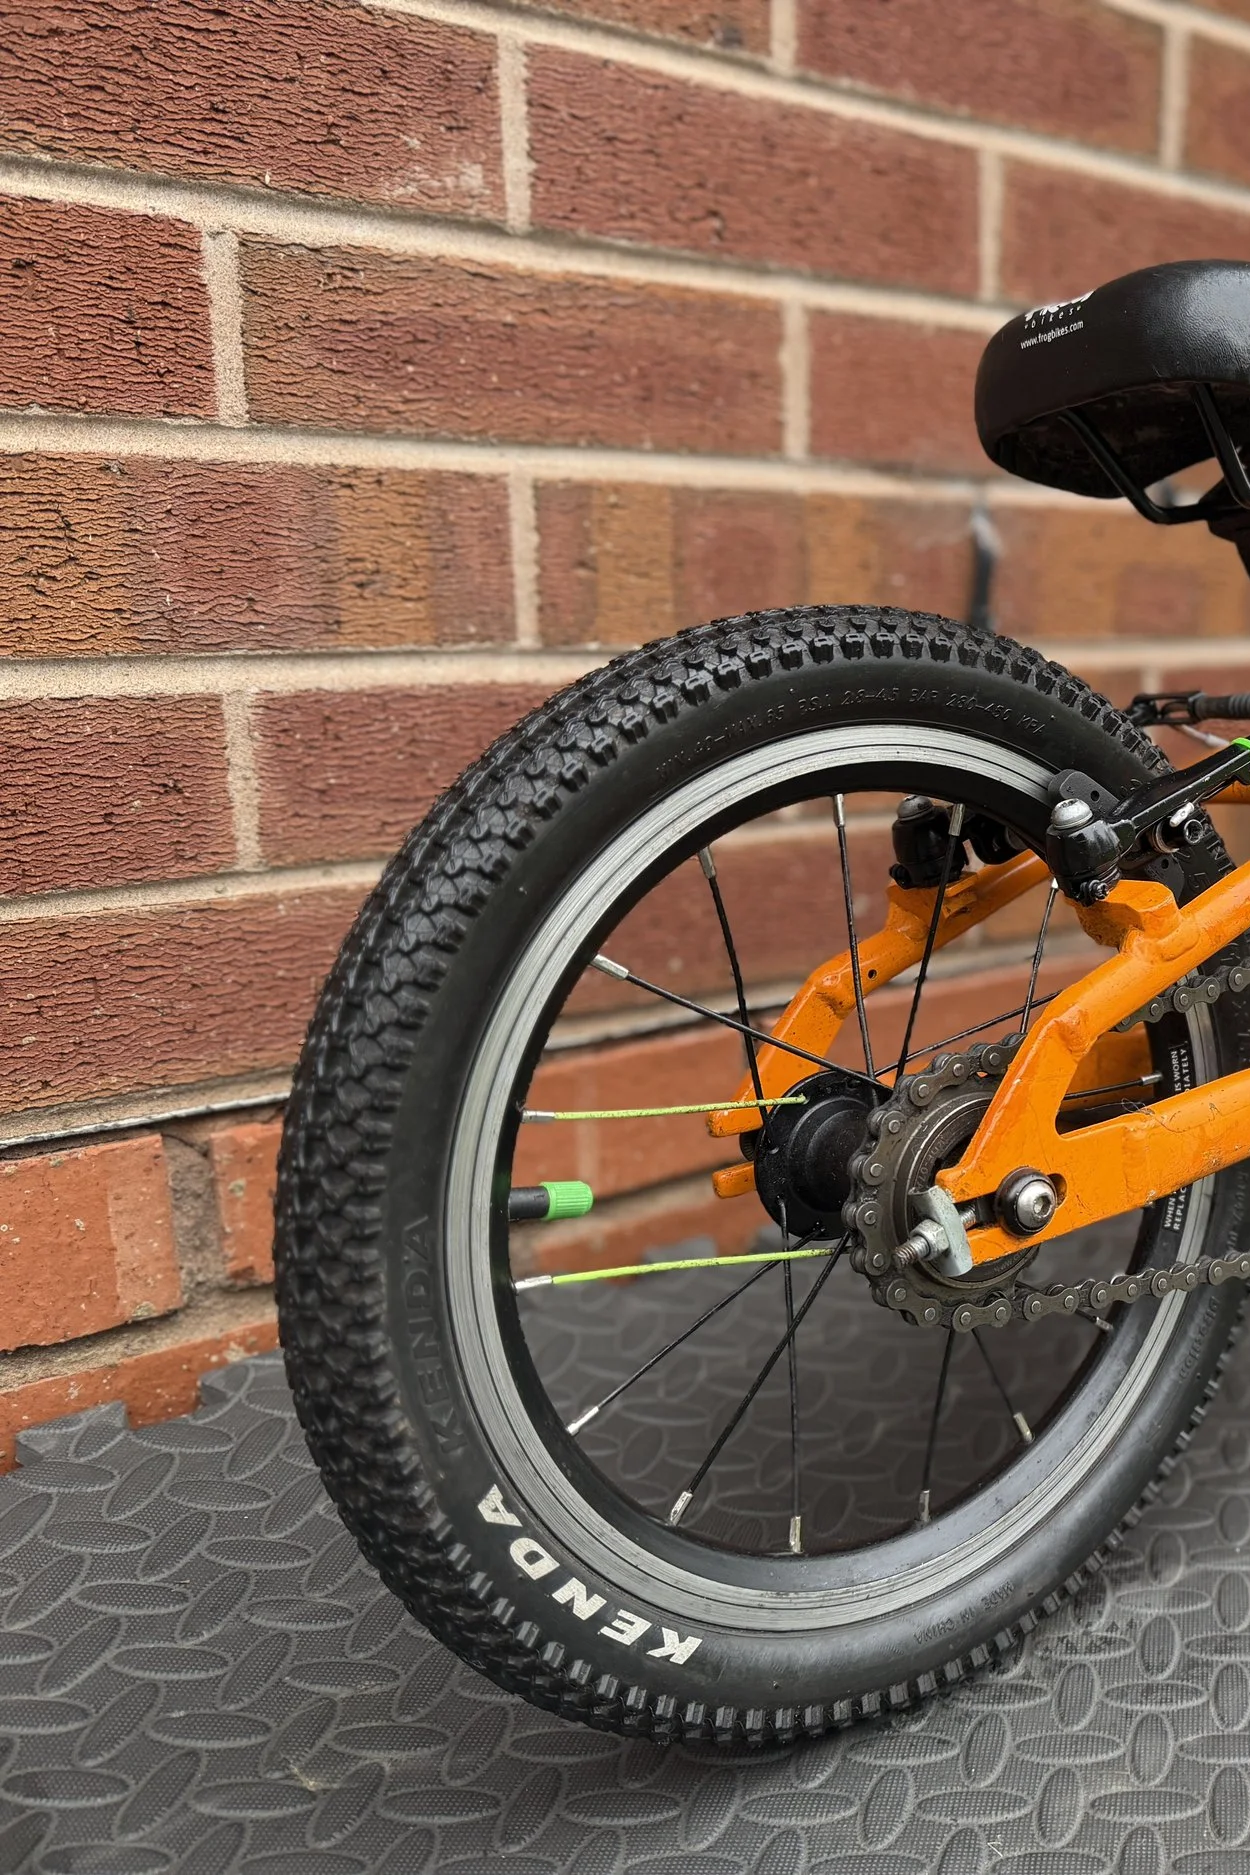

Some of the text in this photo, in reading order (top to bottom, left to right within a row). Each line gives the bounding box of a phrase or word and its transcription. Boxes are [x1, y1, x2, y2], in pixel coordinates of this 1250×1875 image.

[1020, 320, 1084, 350] www.frogbikes.com
[1170, 1050, 1182, 1092] IS WORN
[1164, 1197, 1176, 1228] WHEN
[403, 1215, 468, 1454] KENDA
[477, 1483, 703, 1665] KENDA
[913, 1581, 1015, 1645] MADE IN CHINA
